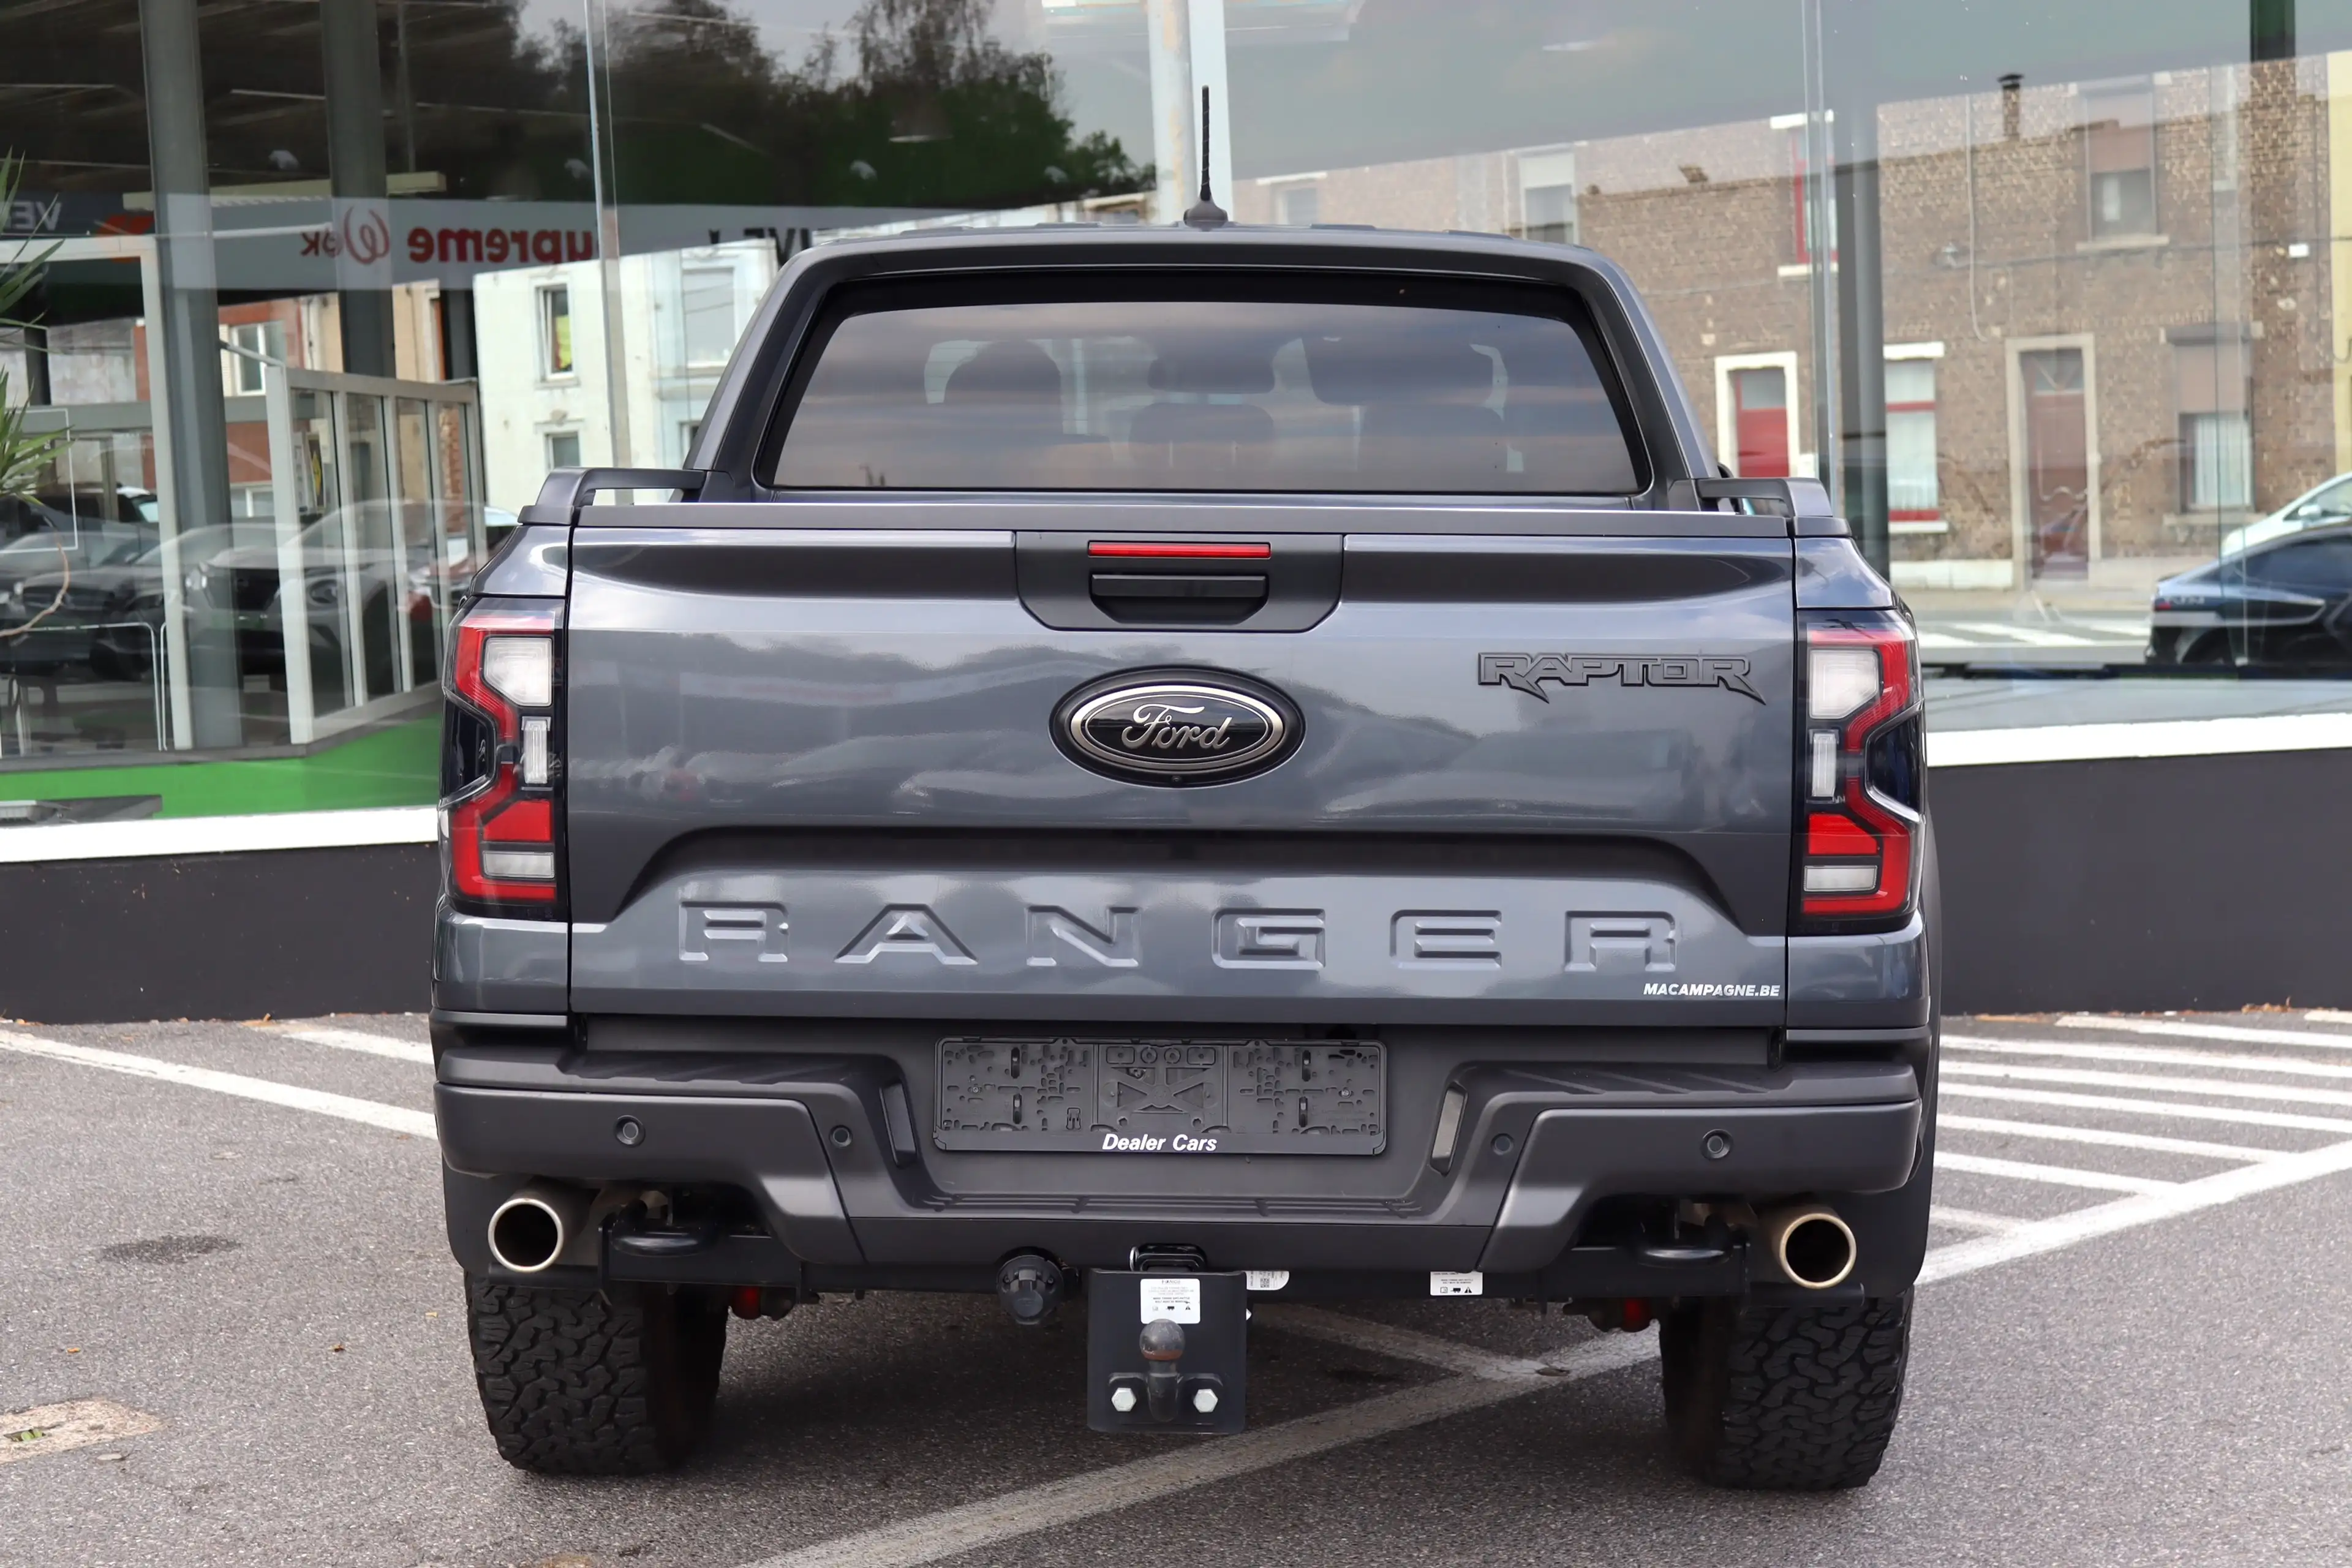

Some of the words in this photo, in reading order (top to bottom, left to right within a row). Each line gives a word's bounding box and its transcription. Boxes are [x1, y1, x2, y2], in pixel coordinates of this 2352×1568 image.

[1477, 652, 1766, 706] RAPTOR
[1121, 703, 1232, 750] Ford
[679, 900, 1676, 972] RANGER
[1643, 982, 1781, 997] MACAMPAGNE.BE
[1102, 1133, 1167, 1151] Dealer
[1172, 1134, 1218, 1152] Cars
